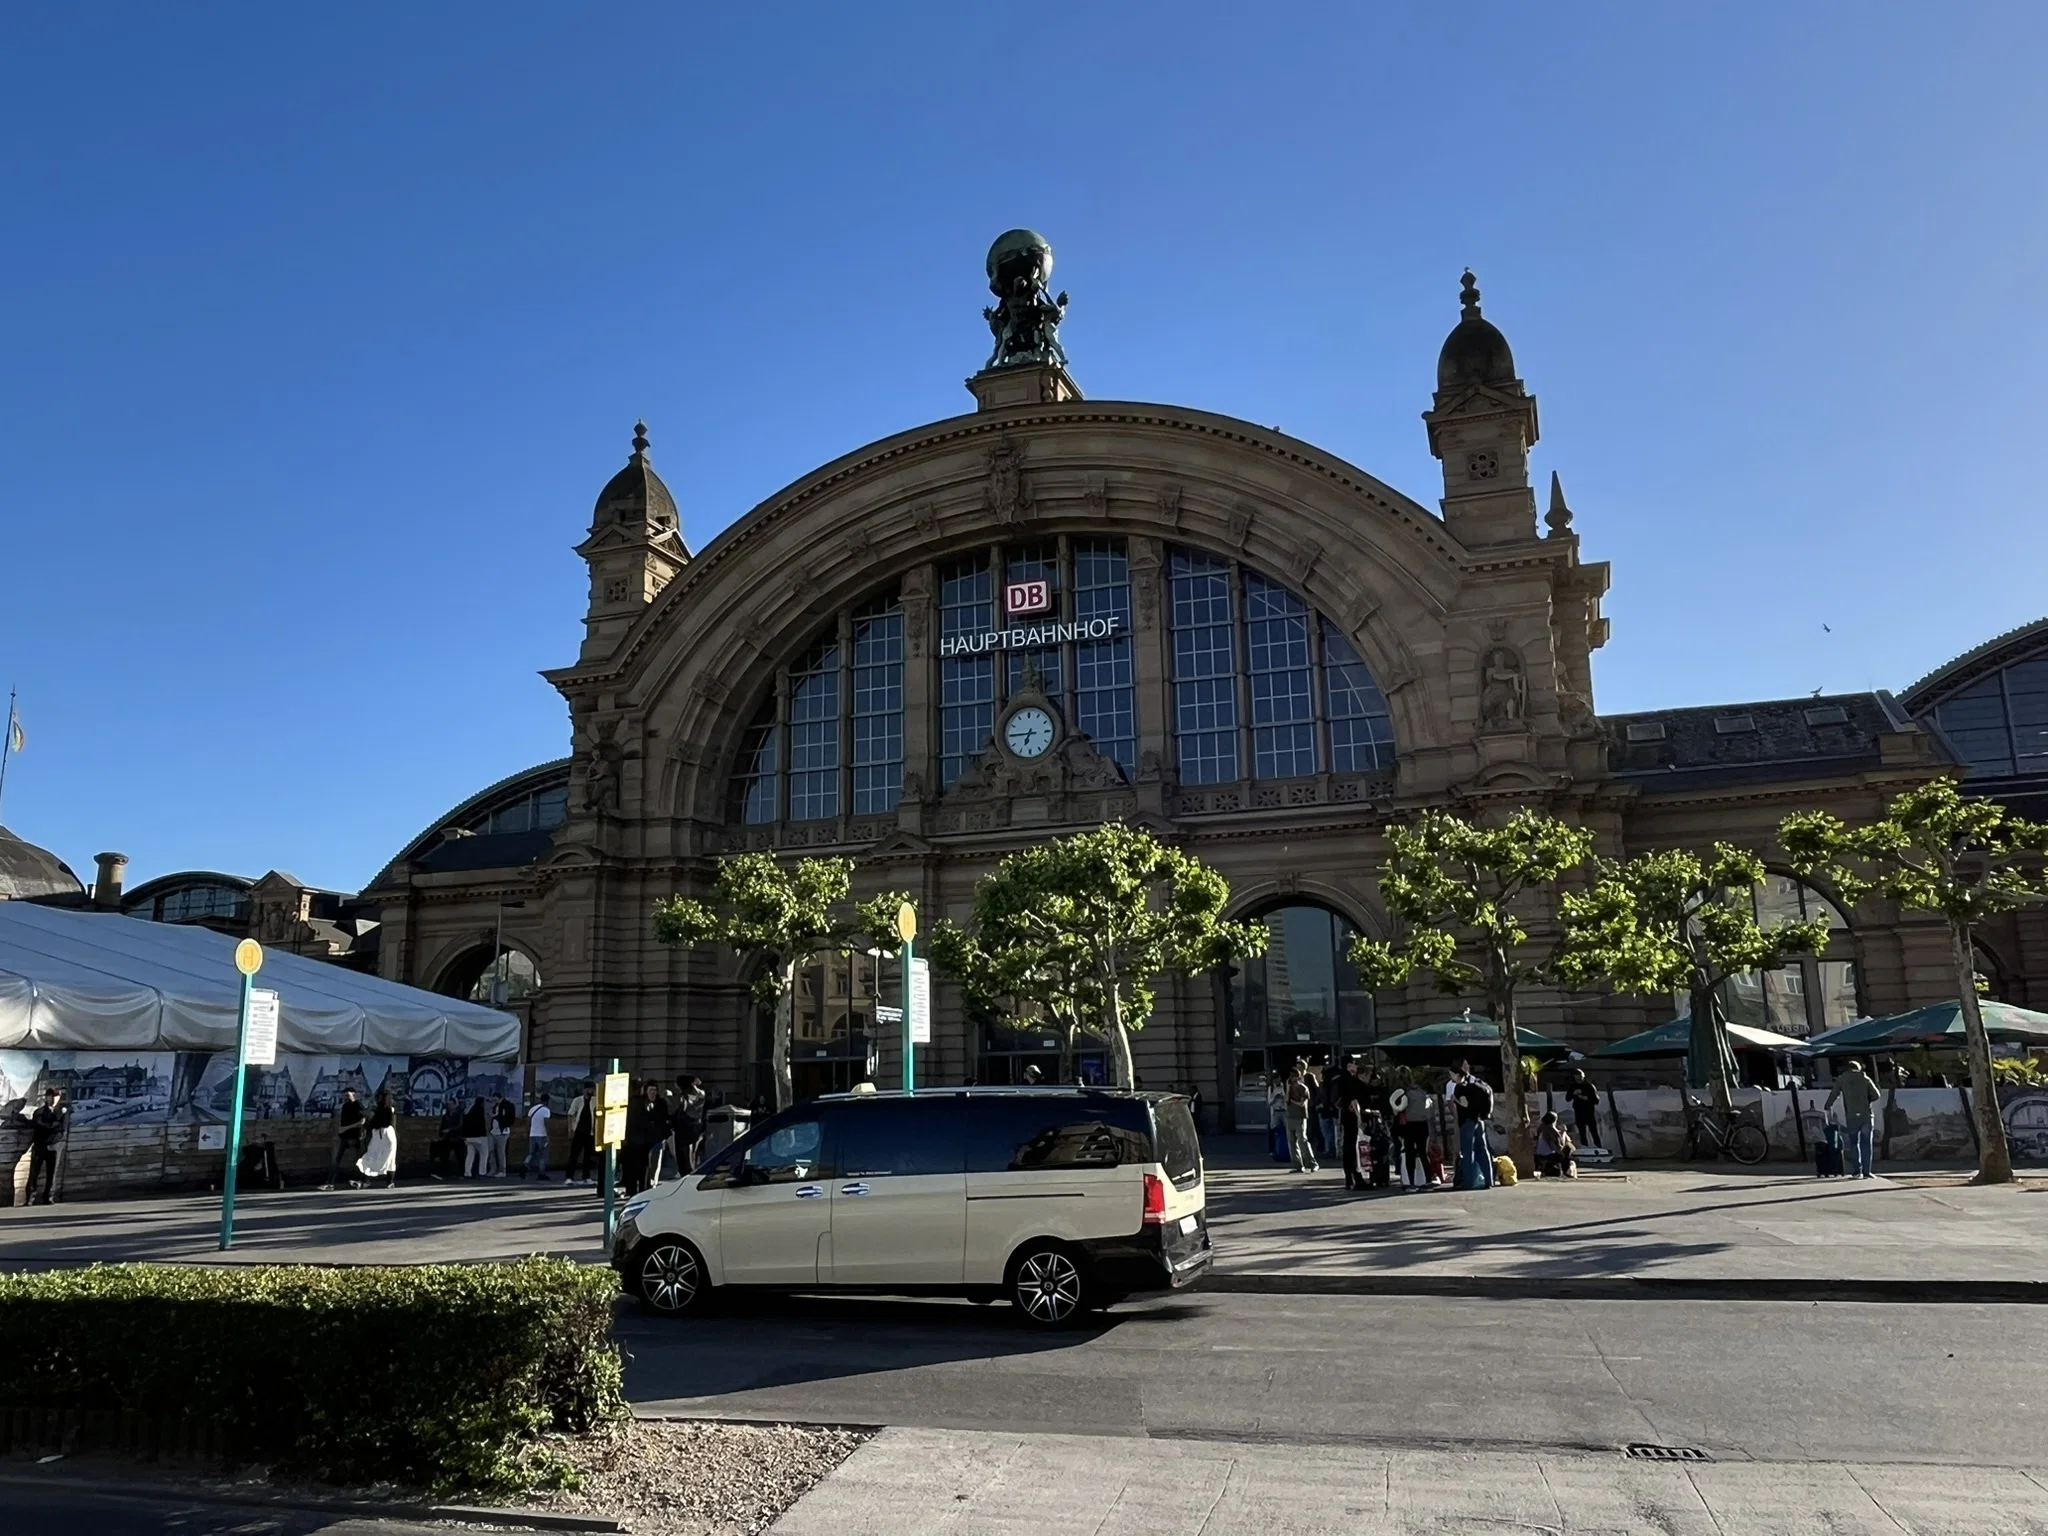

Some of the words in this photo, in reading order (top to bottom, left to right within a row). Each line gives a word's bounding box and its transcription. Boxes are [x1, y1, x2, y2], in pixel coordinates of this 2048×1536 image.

[1010, 584, 1044, 609] DB
[940, 616, 1120, 656] HAUPTBAHNHOF
[243, 947, 254, 967] H
